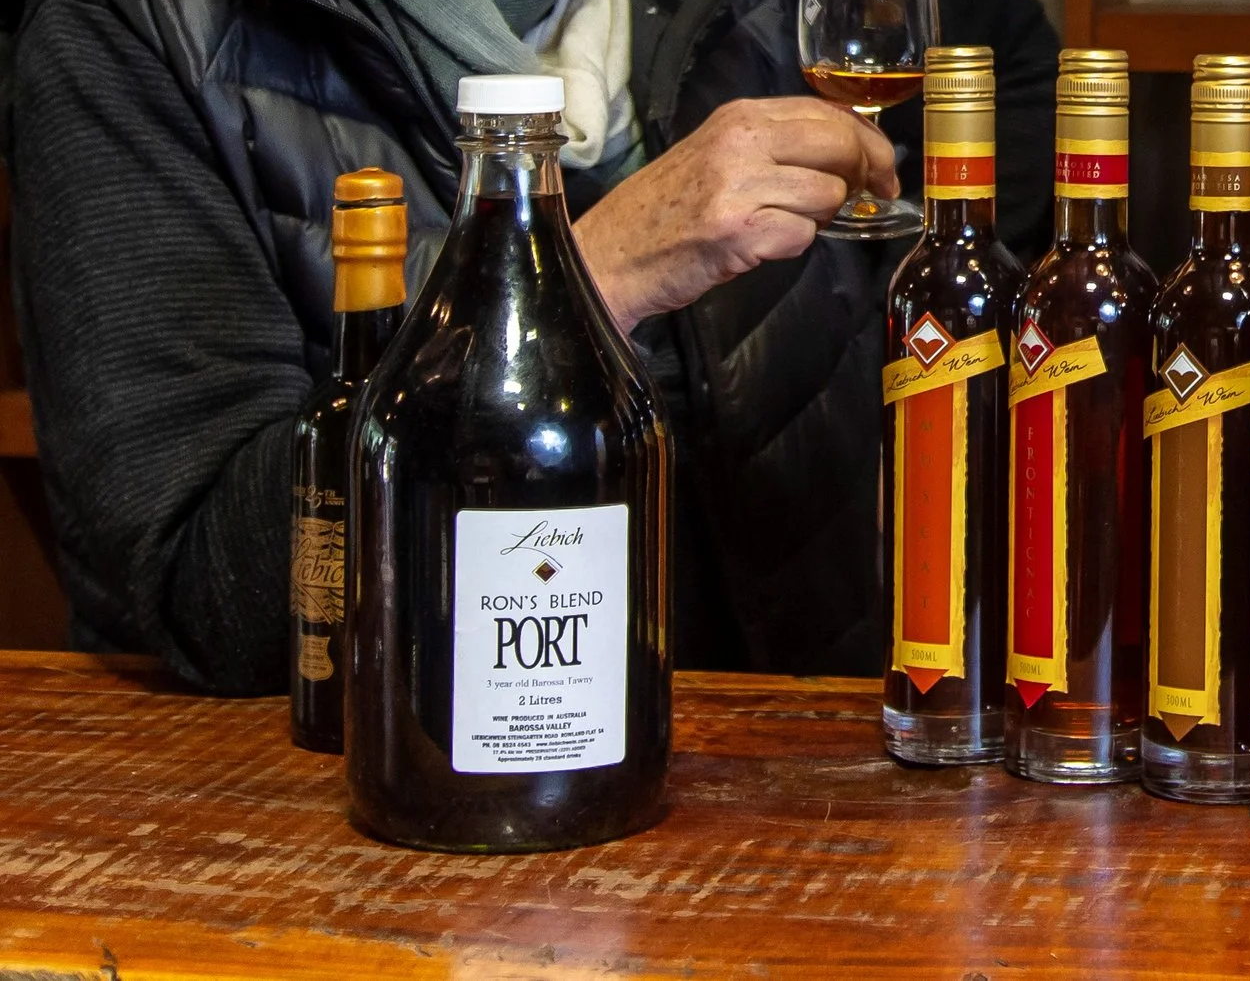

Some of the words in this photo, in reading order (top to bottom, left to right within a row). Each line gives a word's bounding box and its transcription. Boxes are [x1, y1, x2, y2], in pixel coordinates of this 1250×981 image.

[1024, 426, 1037, 620] FRONTIGNAC
[500, 520, 584, 568] Liebich
[481, 595, 538, 610] RON'S
[550, 591, 603, 609] BLEND
[493, 614, 588, 670] PORT
[911, 648, 937, 663] 500ML
[487, 680, 492, 688] 3
[494, 681, 513, 690] year
[515, 679, 529, 688] old
[532, 679, 564, 688] Barossa
[567, 676, 593, 686] Tawny
[518, 696, 526, 706] 2
[529, 695, 563, 706] Litres
[1166, 694, 1193, 708] 500ML
[556, 711, 587, 720] AUSTRALIA
[509, 723, 544, 732] BAROSSA
[546, 722, 572, 731] VALLEY
[561, 730, 585, 738] ROWLAND
[585, 728, 596, 736] FLAT
